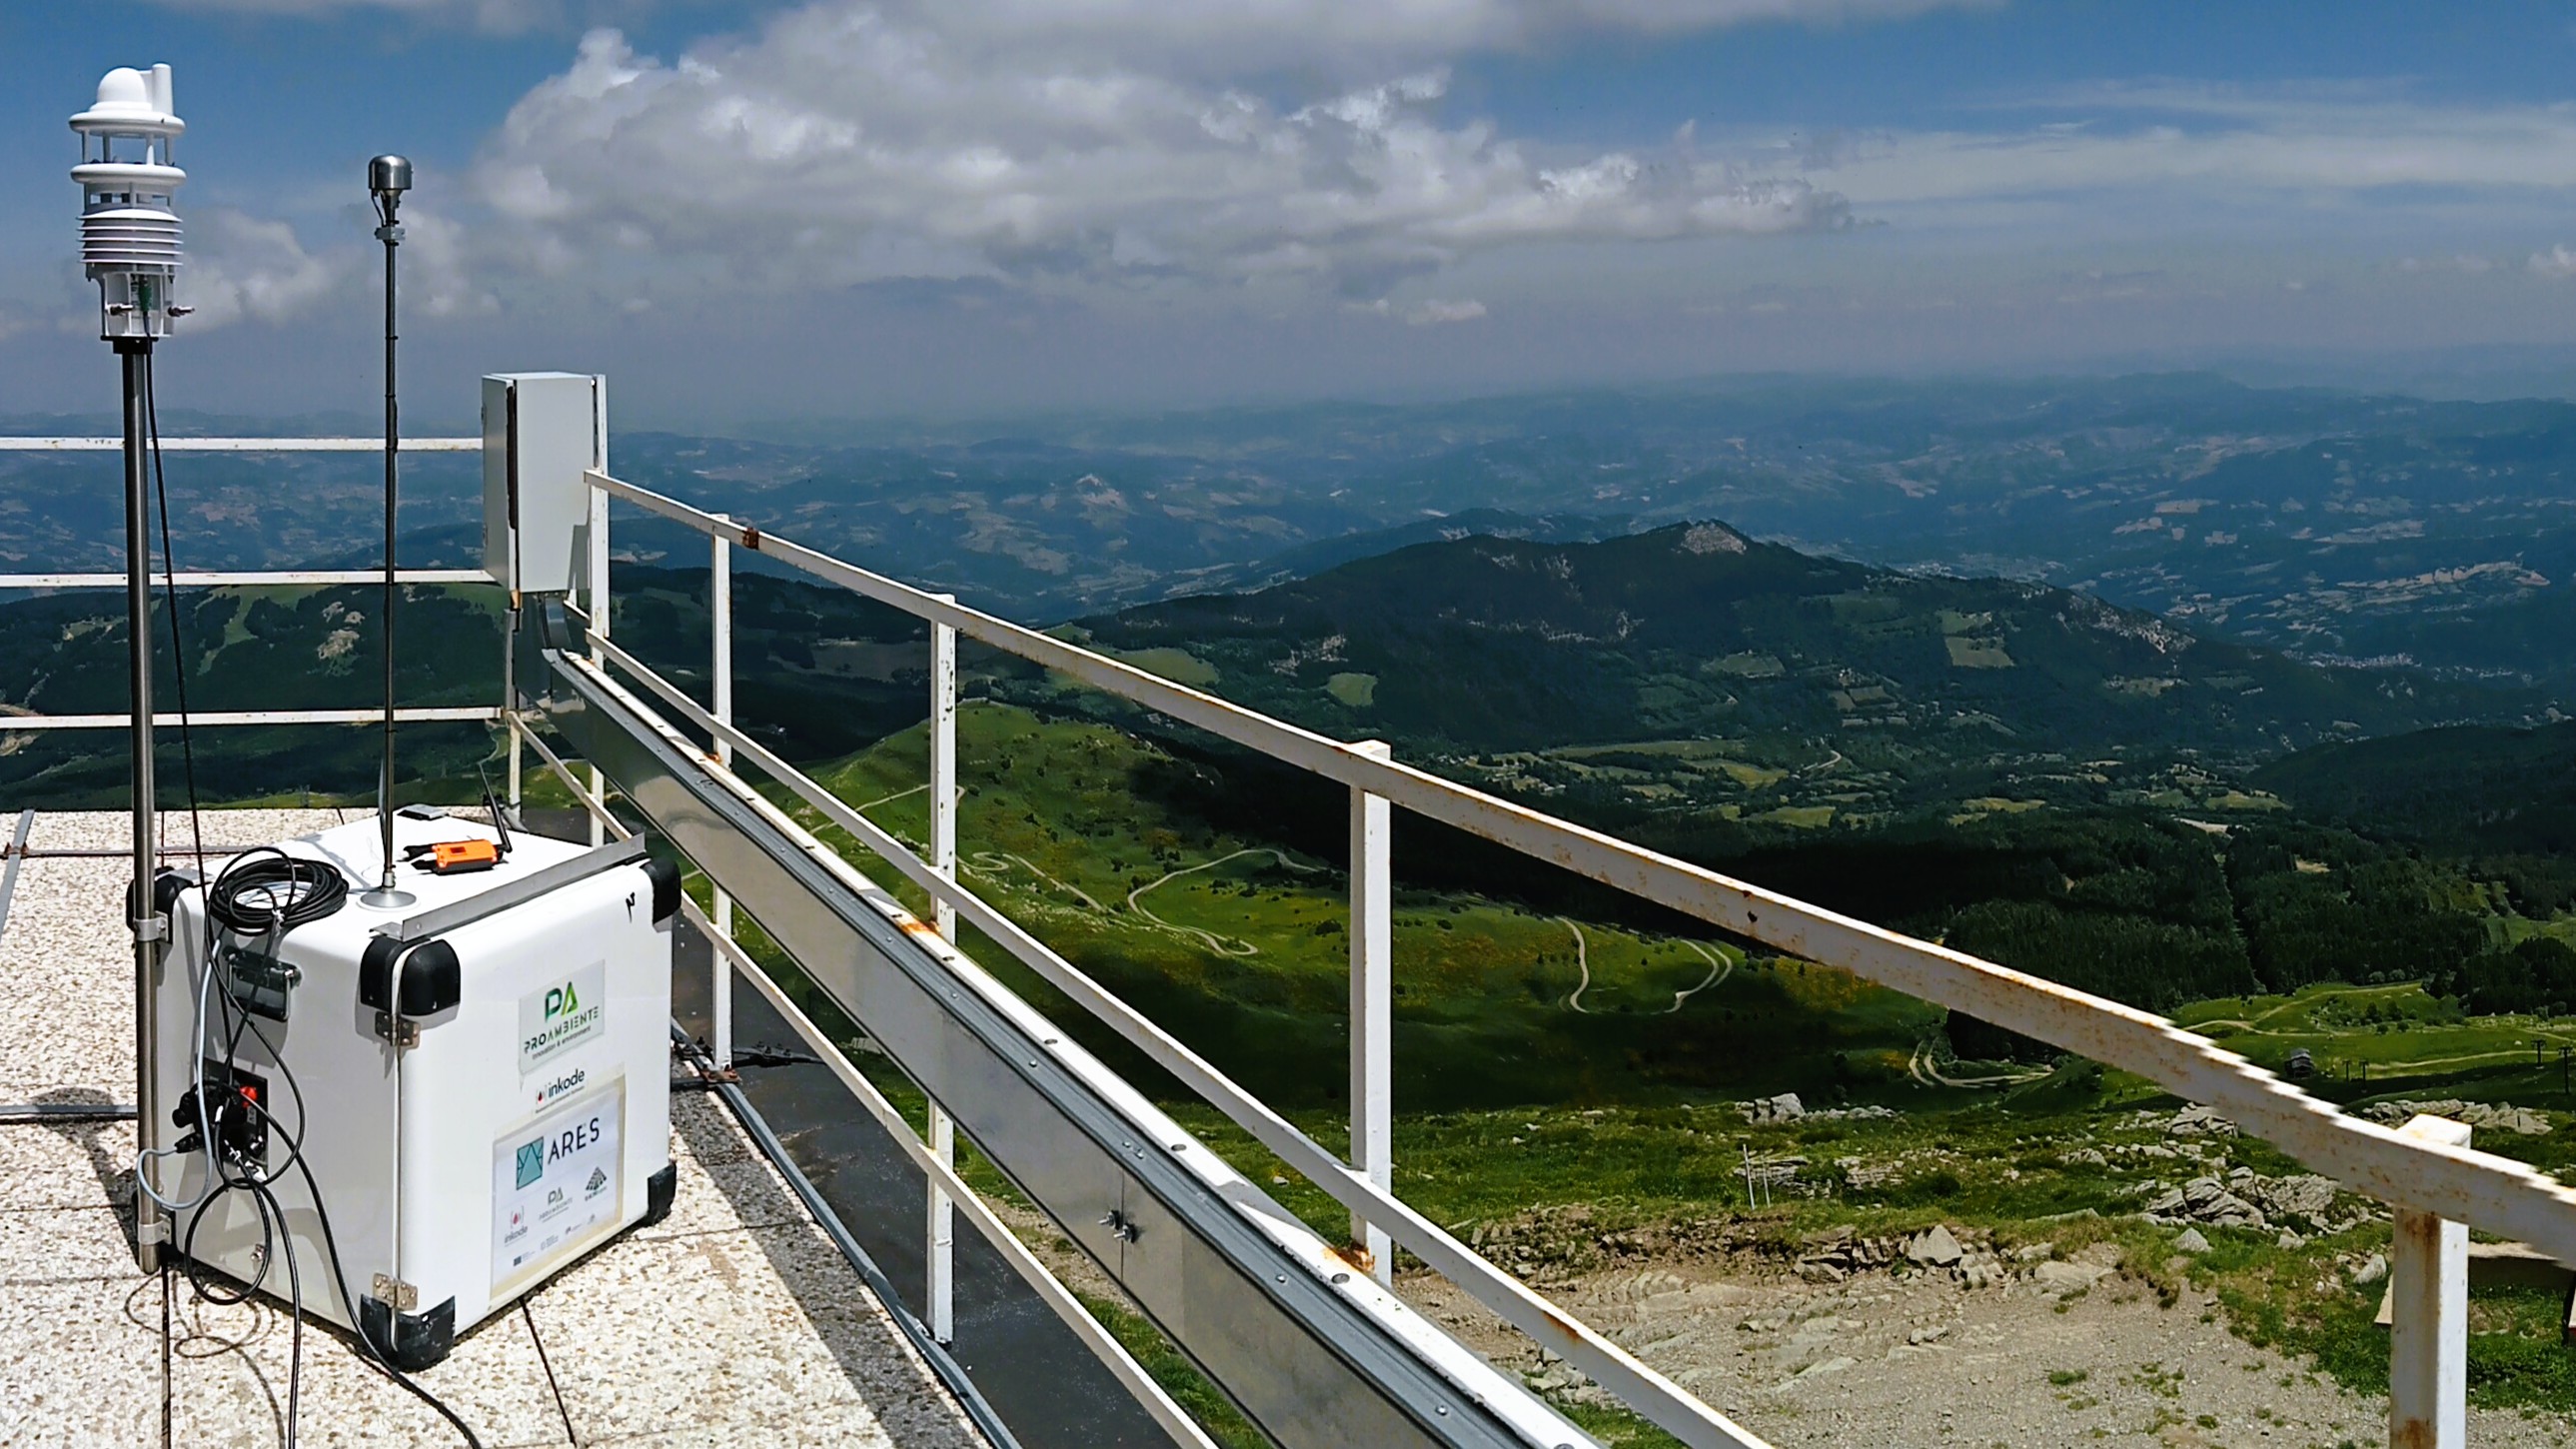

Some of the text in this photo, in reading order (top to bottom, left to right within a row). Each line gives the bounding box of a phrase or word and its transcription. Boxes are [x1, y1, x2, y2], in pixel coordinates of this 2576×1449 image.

[545, 981, 579, 1022] PA
[524, 1005, 599, 1054] PROAMBIENTE
[548, 1068, 586, 1098] inkode
[548, 1117, 600, 1165] ARES
